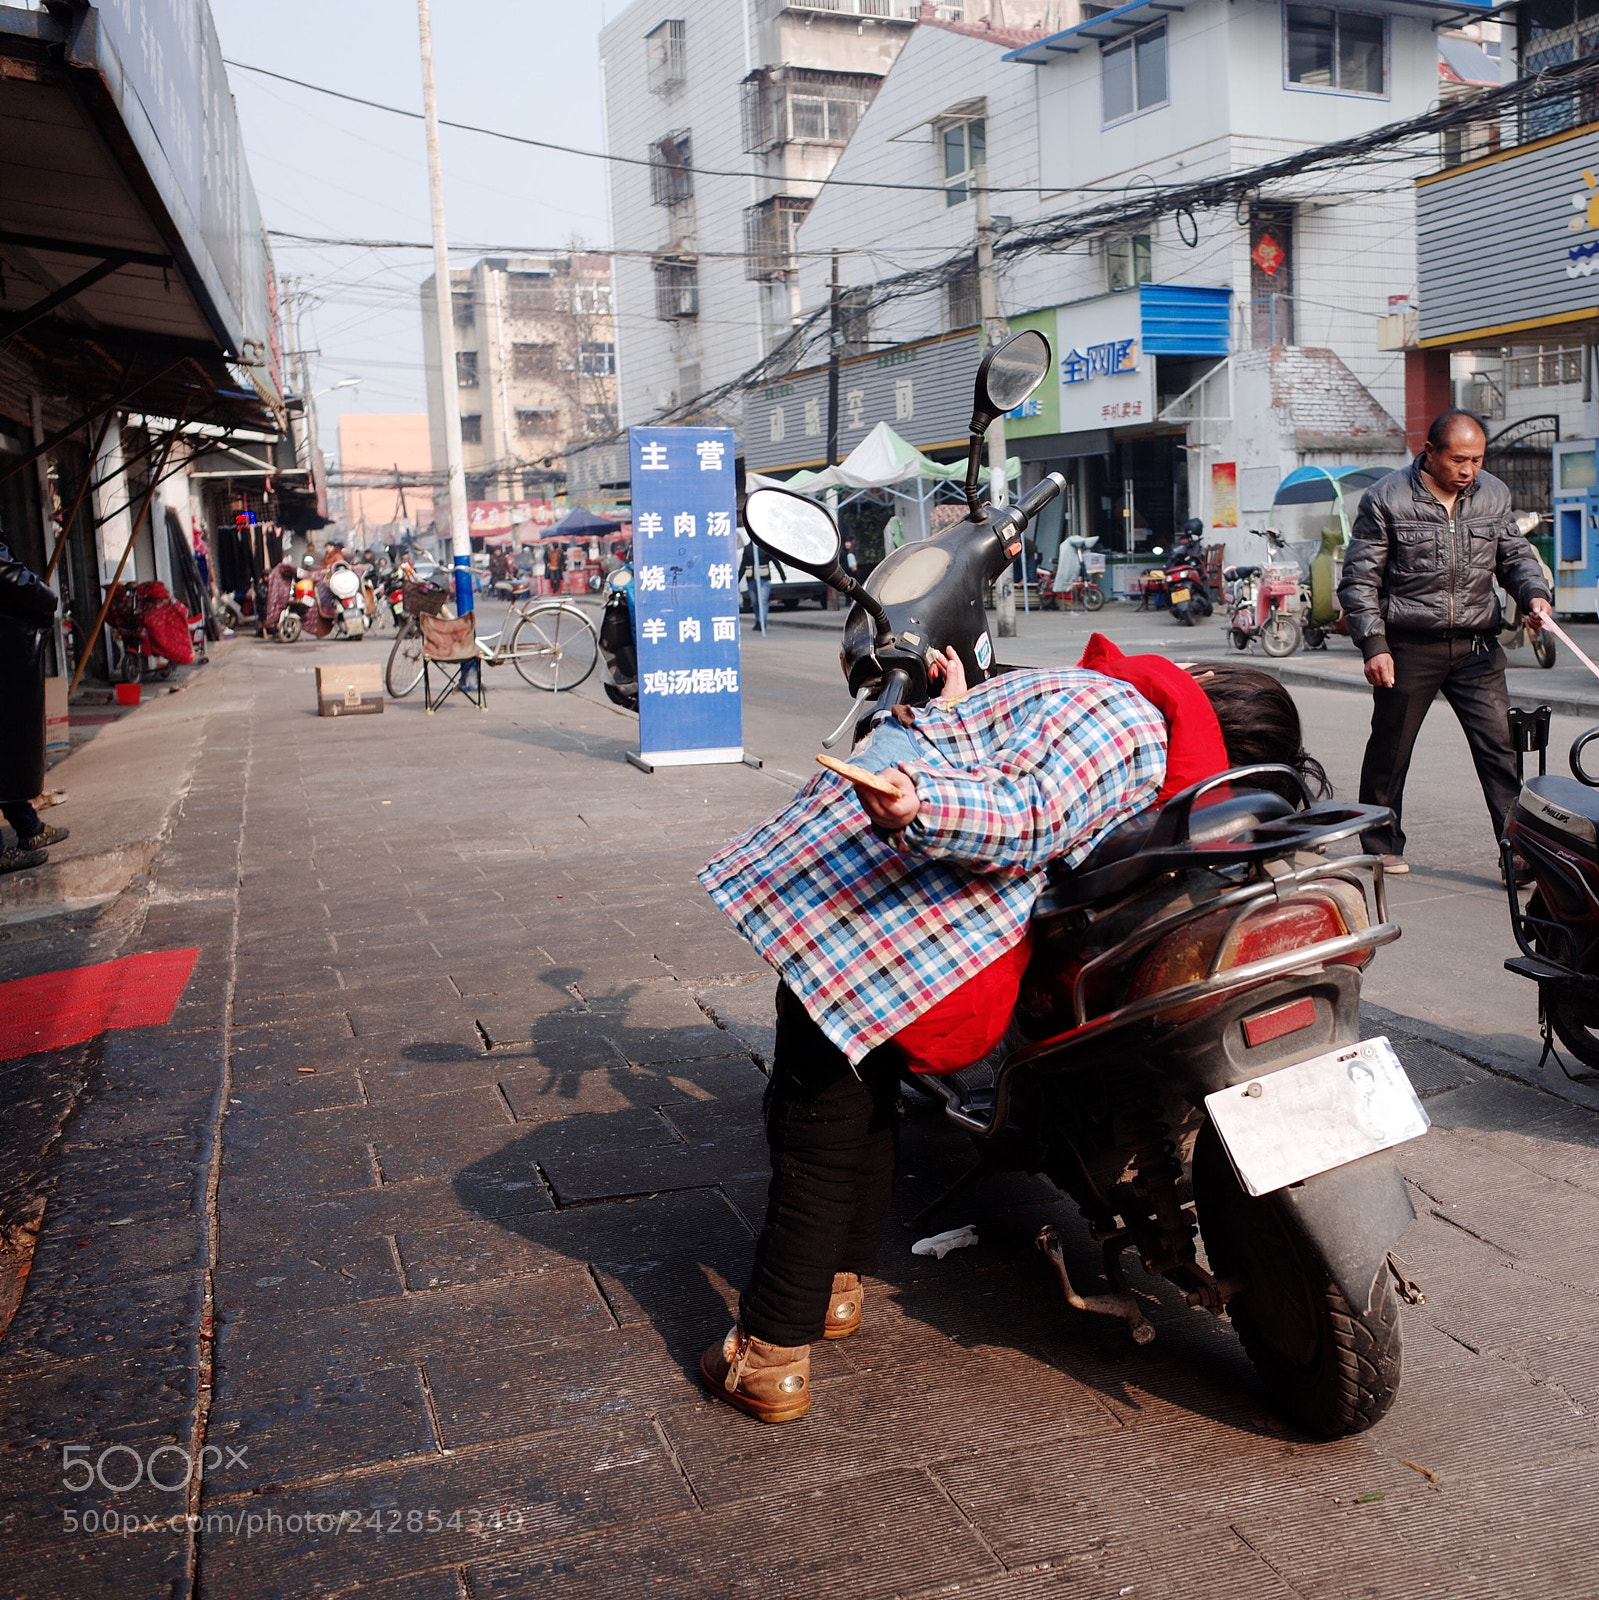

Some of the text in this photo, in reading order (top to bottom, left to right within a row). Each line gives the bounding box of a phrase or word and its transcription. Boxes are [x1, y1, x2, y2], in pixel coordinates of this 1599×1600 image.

[1061, 339, 1136, 384] 全网通
[1101, 401, 1142, 420] 手机卖场
[640, 441, 724, 471] 主营
[638, 511, 731, 539] 羊肉汤
[639, 563, 733, 592] 烧饼
[642, 616, 737, 645] 羊肉面
[643, 667, 739, 696] 鸡汤馄饨
[1542, 806, 1570, 823] PHILLIPS
